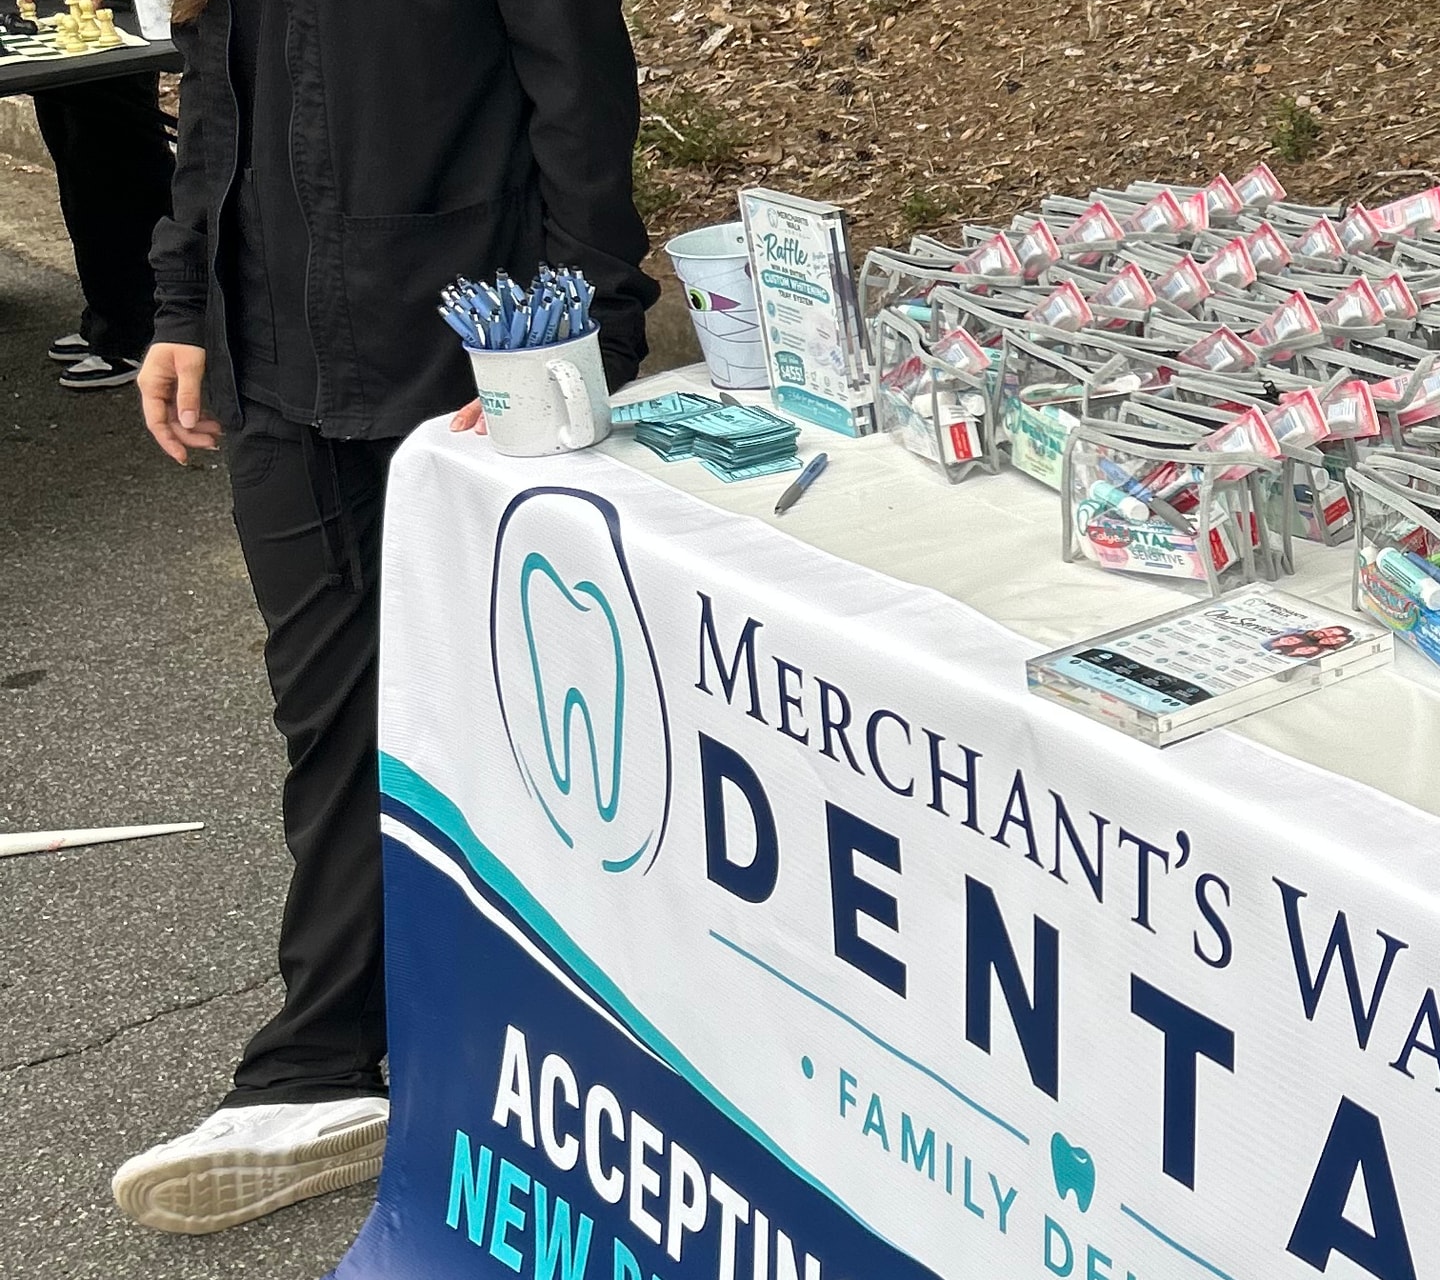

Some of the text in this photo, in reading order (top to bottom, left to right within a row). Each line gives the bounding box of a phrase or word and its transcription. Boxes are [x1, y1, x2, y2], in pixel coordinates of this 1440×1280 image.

[764, 233, 808, 265] Raffle
[1132, 548, 1184, 565] SENSITIVE
[838, 1068, 1018, 1233] FAMILY
